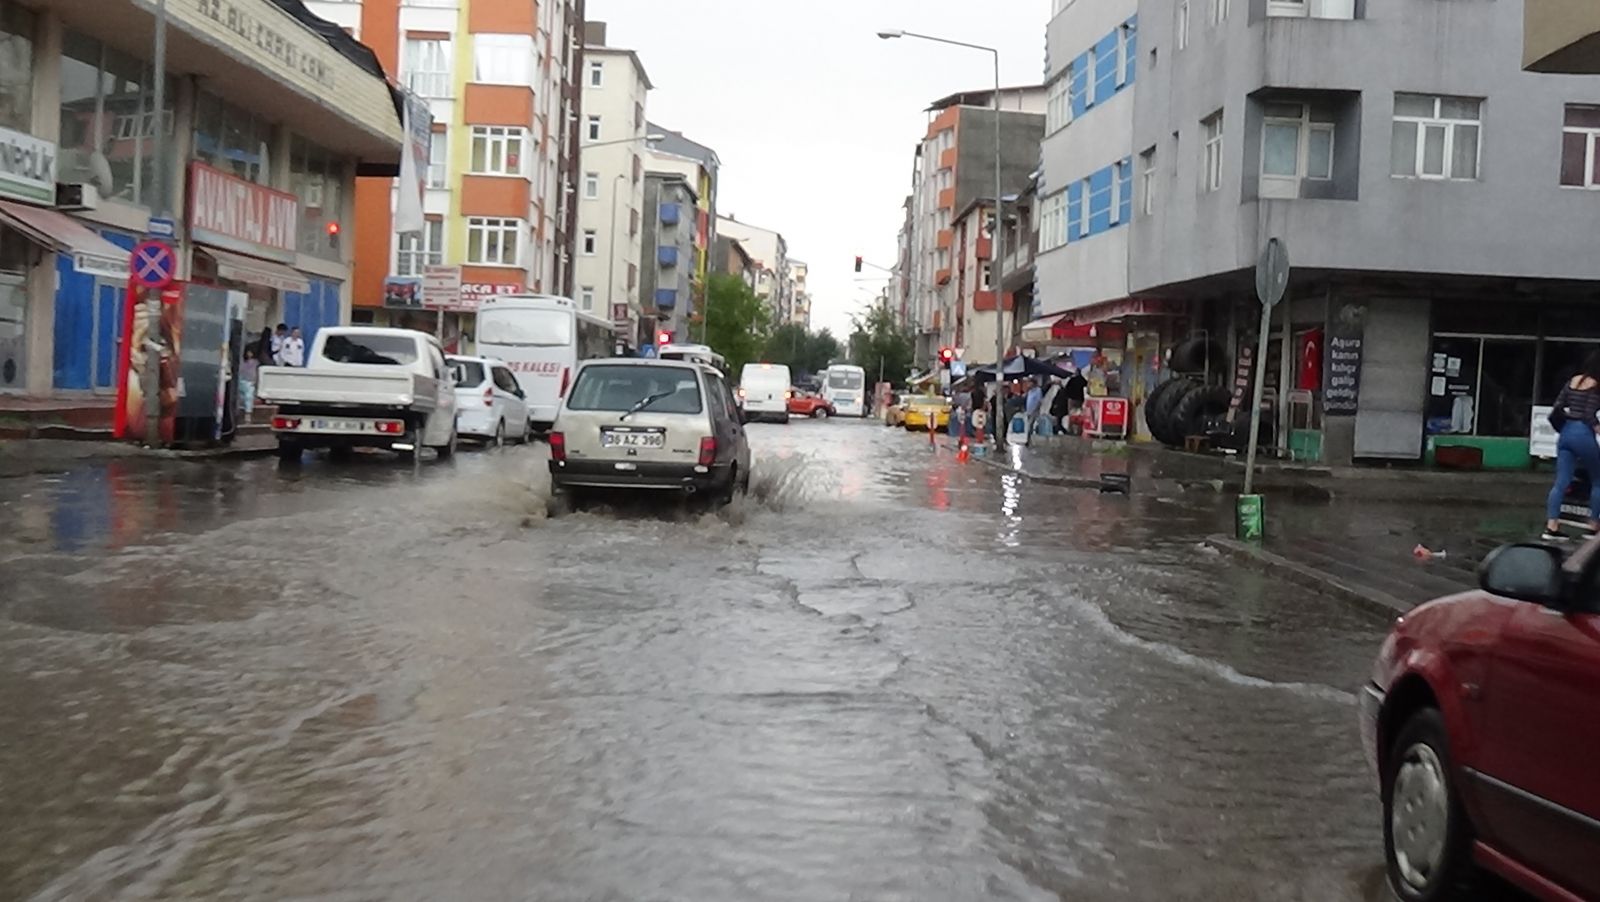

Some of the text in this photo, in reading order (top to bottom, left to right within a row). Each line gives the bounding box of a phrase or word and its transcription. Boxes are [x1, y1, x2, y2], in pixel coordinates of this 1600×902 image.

[192, 168, 263, 243] AVANTAJ
[607, 435, 661, 446] 36 AZ 396
